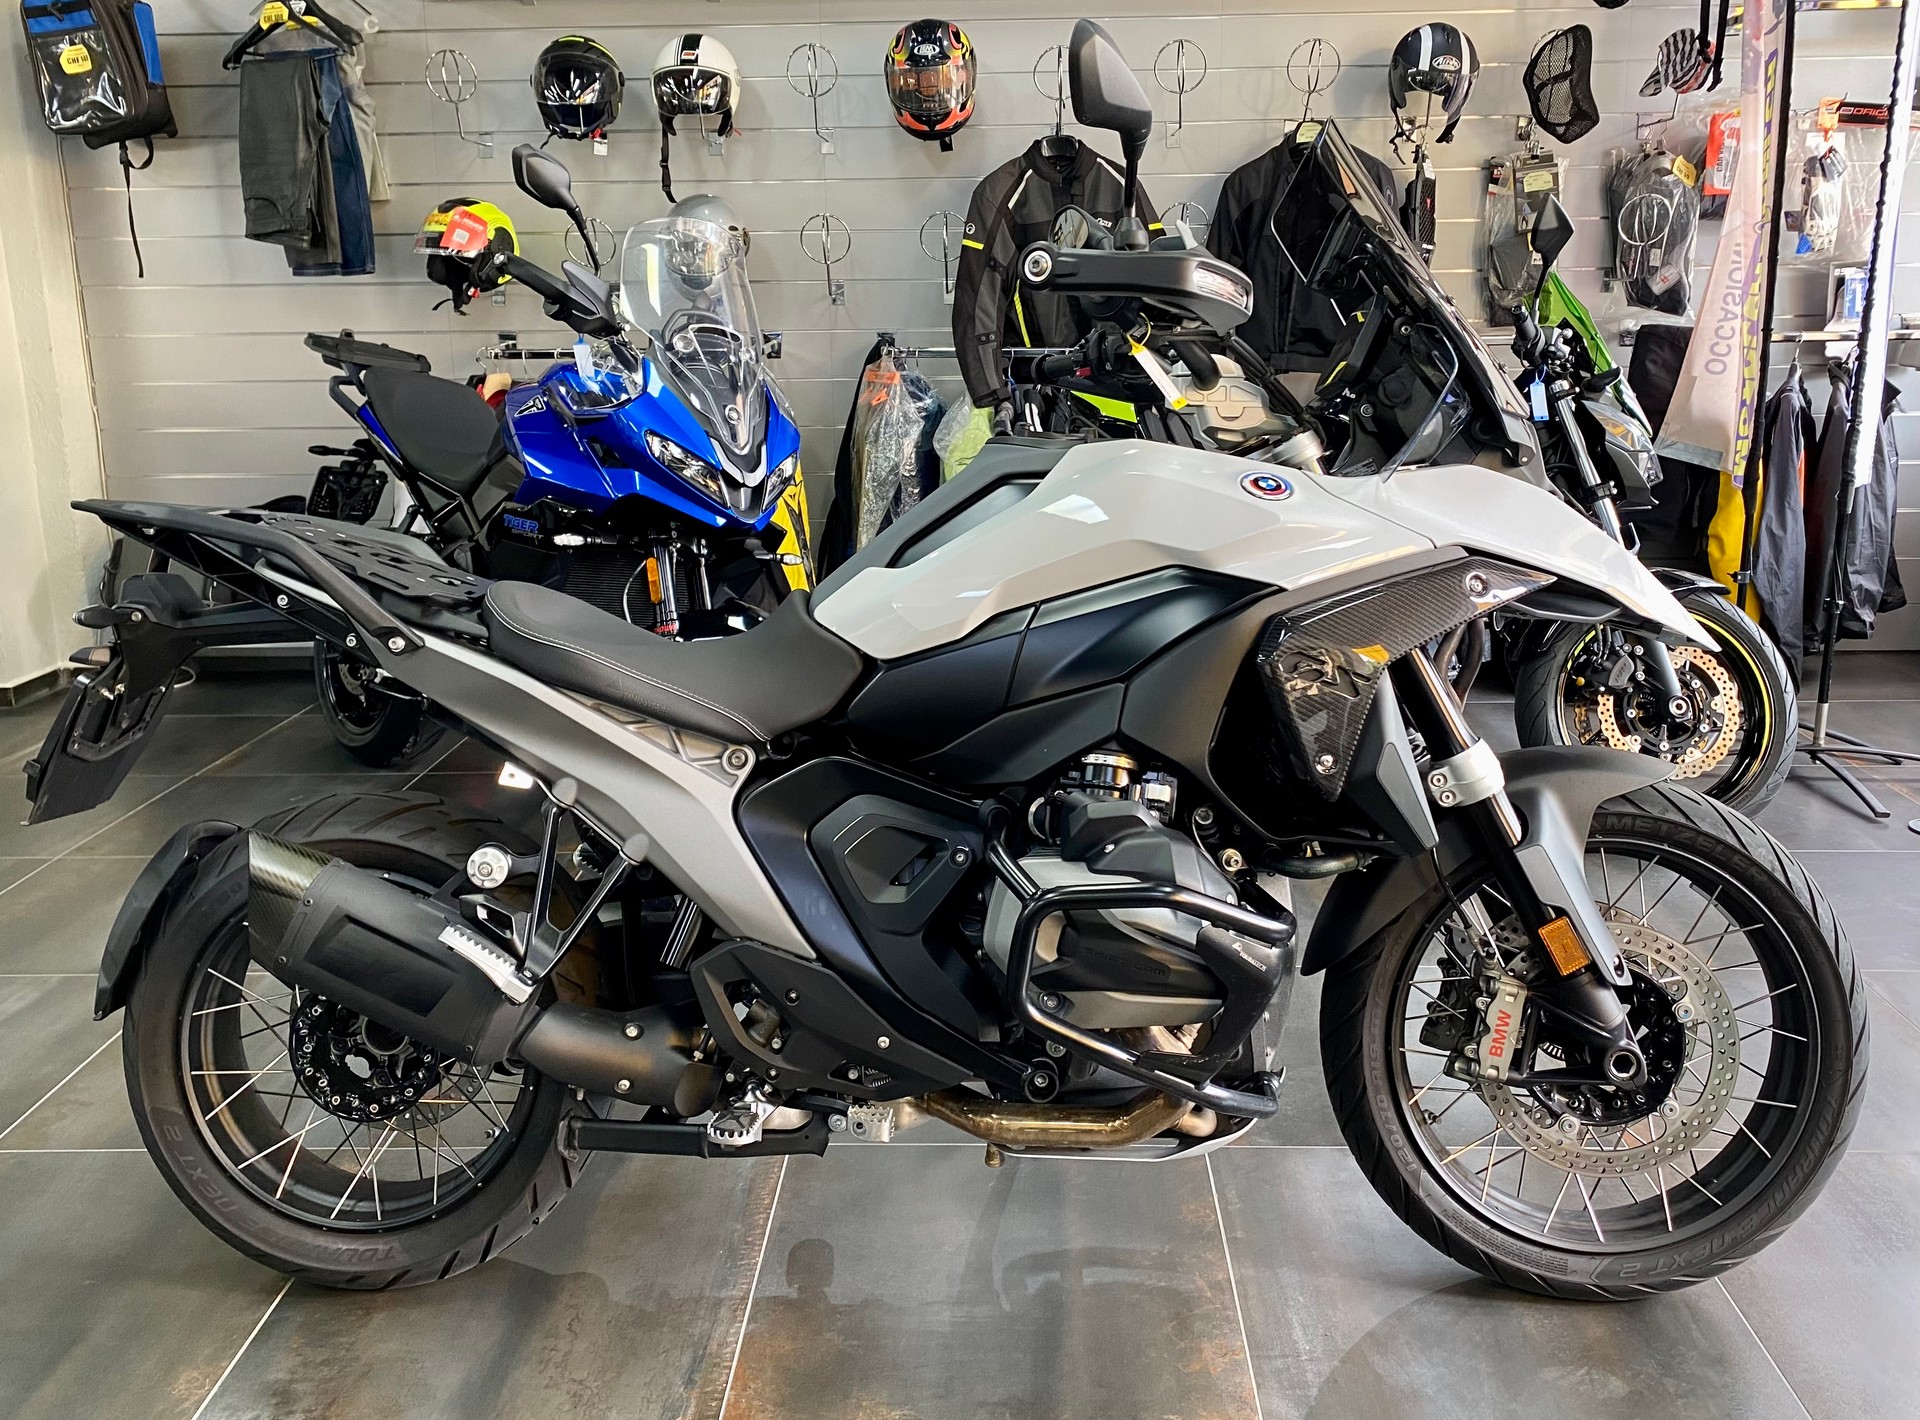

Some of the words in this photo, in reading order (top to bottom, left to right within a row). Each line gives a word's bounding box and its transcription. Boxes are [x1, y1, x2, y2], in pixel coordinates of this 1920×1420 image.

[67, 56, 80, 64] CHF
[503, 514, 539, 533] TIGER
[511, 528, 544, 540] SPORT
[1606, 814, 1768, 884] METZELER
[1489, 1009, 1512, 1058] BMW
[163, 1124, 184, 1142] 2
[1376, 1094, 1418, 1172] 120/70
[1739, 1093, 1839, 1239] TOURANCE
[1619, 1262, 1642, 1278] 2
